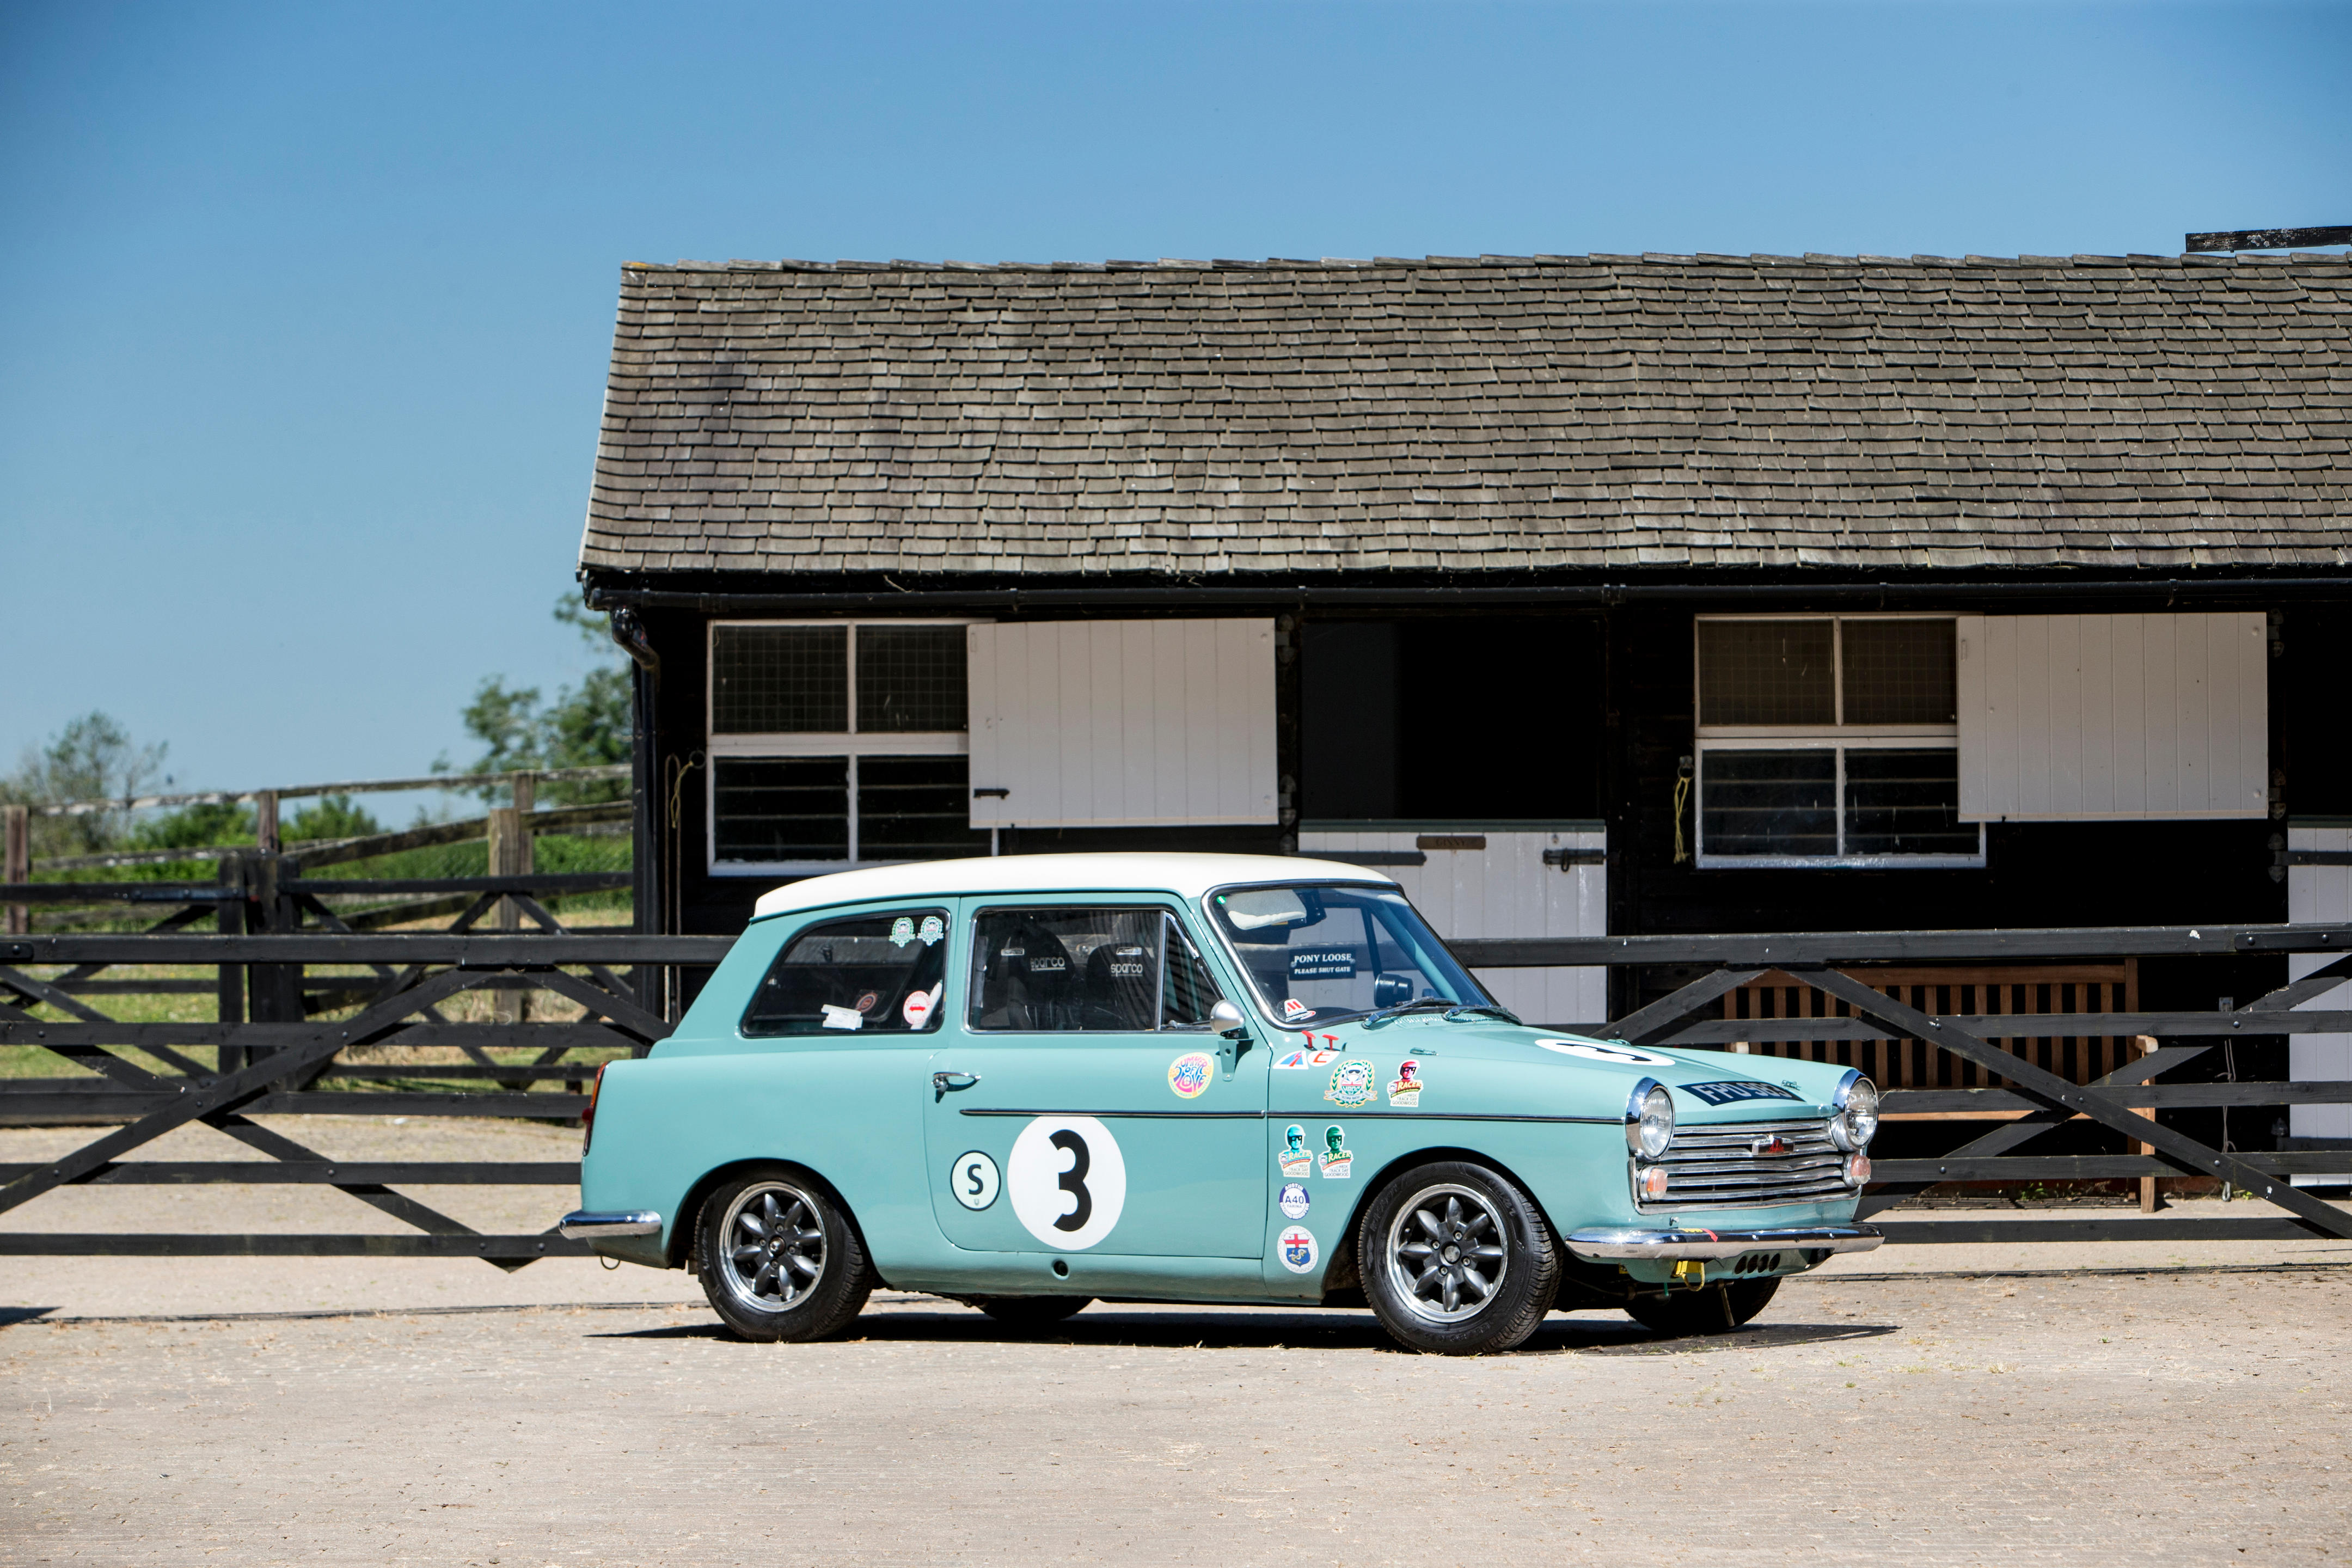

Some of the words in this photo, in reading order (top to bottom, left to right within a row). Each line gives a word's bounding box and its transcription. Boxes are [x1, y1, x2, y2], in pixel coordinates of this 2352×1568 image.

[1294, 954, 1319, 963] PONY
[1322, 953, 1351, 962] LOOSE
[1111, 963, 1143, 977] sparco
[1397, 1081, 1422, 1091] RACER
[1289, 1152, 1311, 1161] RACER
[1328, 1152, 1351, 1162] RACER
[967, 1164, 983, 1195] S
[1049, 1129, 1092, 1232] 3
[1285, 1183, 1304, 1191] AUSTIN
[1285, 1196, 1304, 1204] A40
